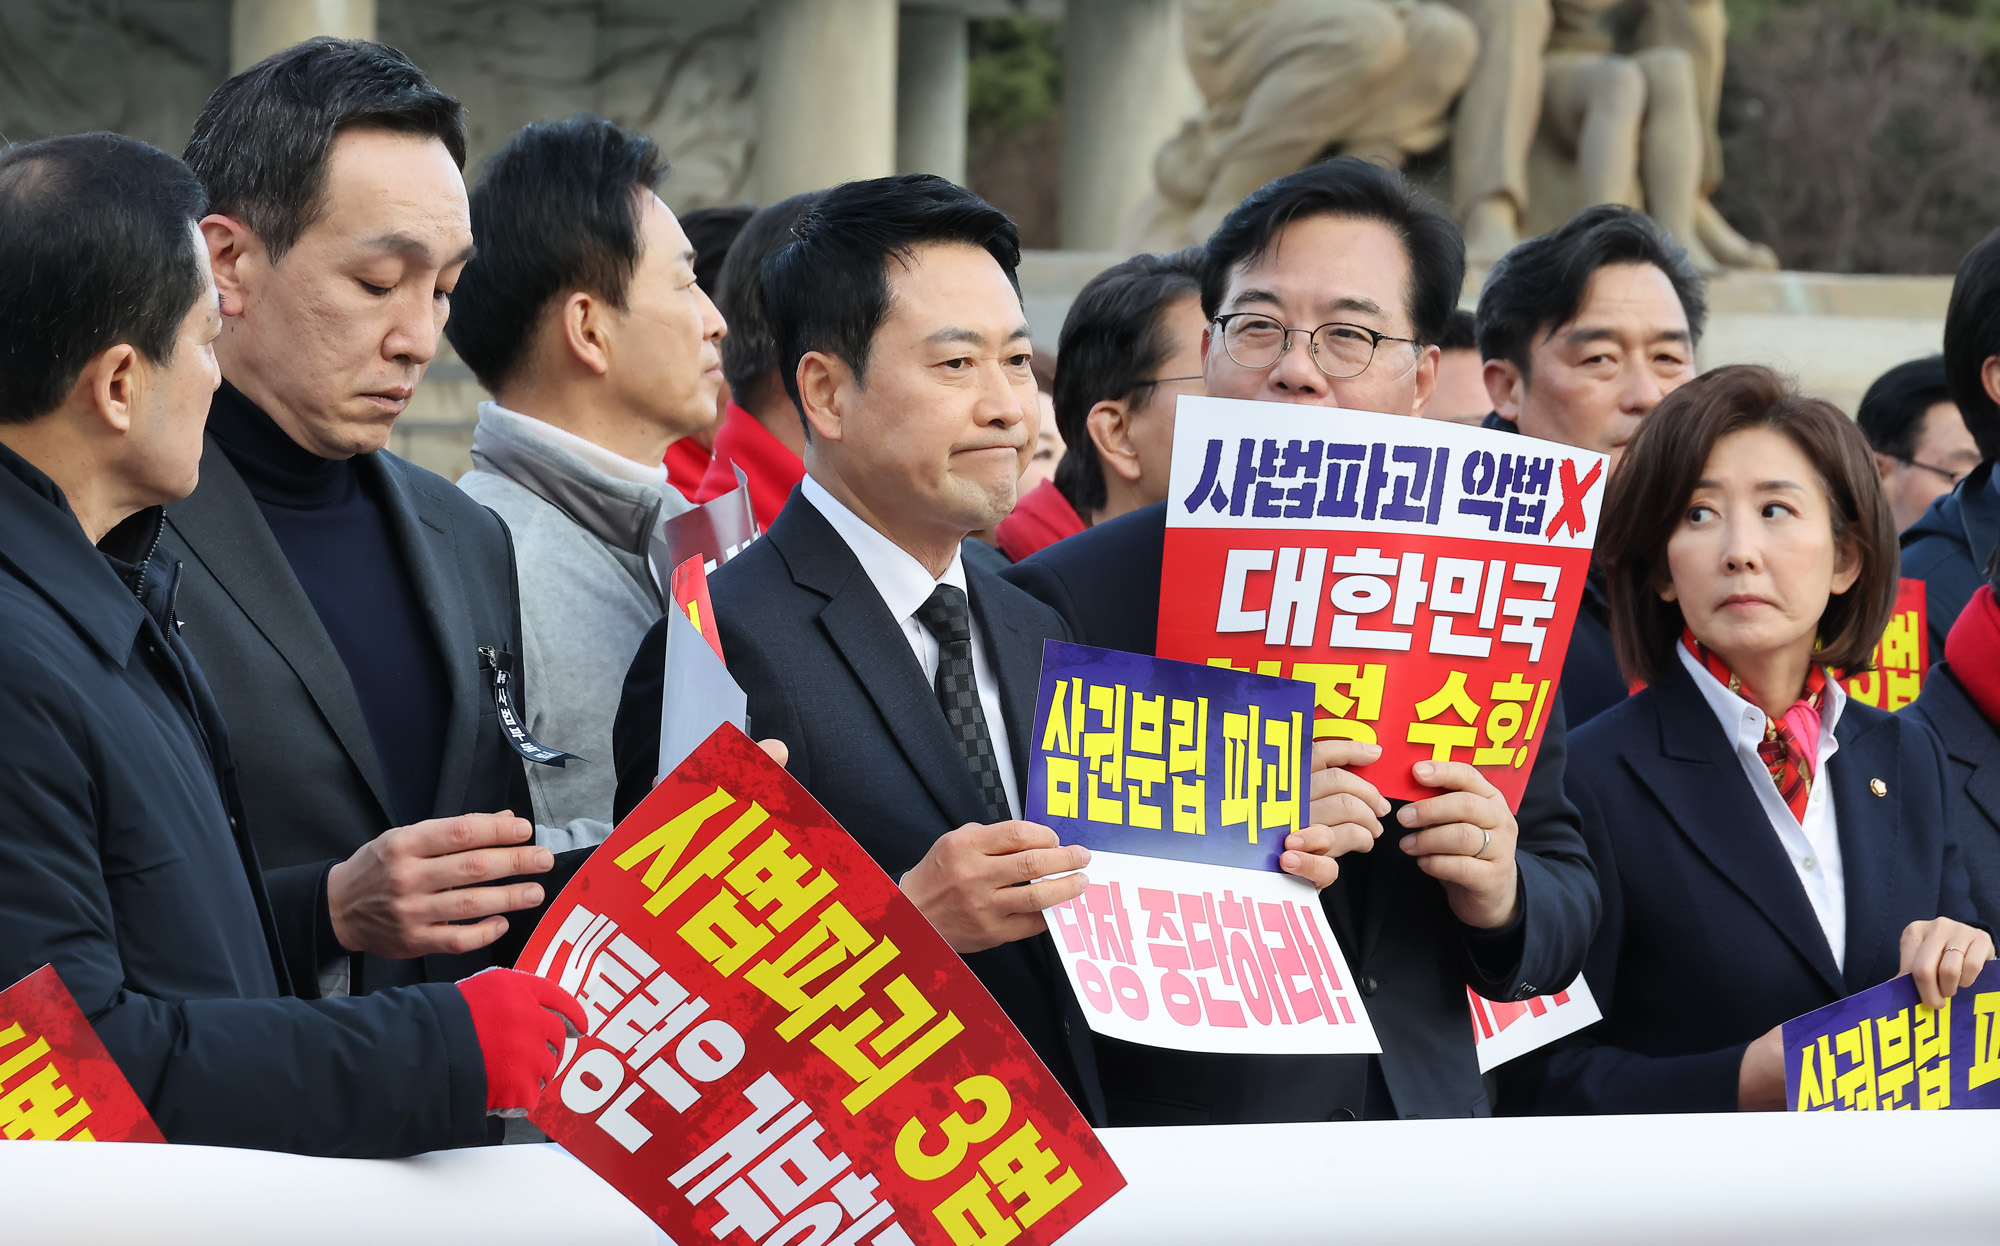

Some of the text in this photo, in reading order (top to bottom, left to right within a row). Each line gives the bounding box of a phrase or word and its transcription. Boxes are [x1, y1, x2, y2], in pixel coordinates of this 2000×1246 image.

[1183, 437, 1553, 536] 사법파괴 악법
[1215, 547, 1562, 662] 대한민국
[1041, 676, 1303, 844] 삼권분립 파괴
[1406, 670, 1552, 769] 수호!
[612, 785, 1083, 1246] 사법파괴 3법
[1041, 877, 1150, 1021] 당장
[1137, 887, 1357, 1029] 중단하라!
[667, 1070, 918, 1246] 거부하
